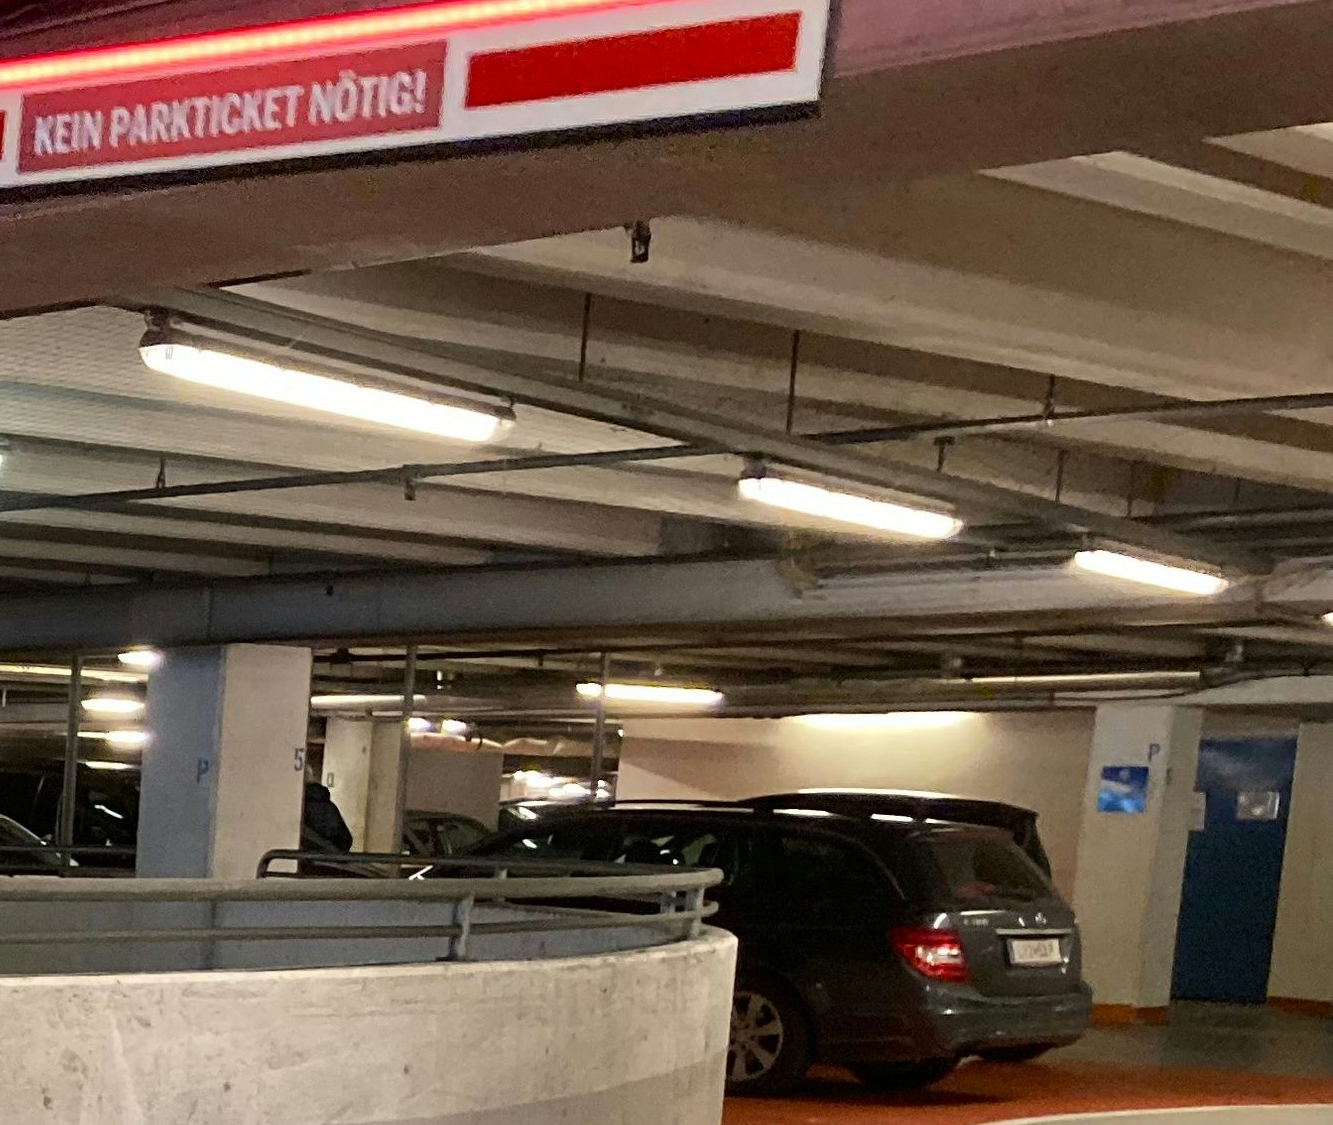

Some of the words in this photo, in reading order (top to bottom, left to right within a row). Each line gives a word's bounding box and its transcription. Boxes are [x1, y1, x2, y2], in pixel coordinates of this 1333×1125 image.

[33, 111, 103, 156] KEIN
[109, 86, 305, 148] PARKTICKET
[308, 69, 427, 125] NÖTIG!
[294, 748, 304, 771] 5
